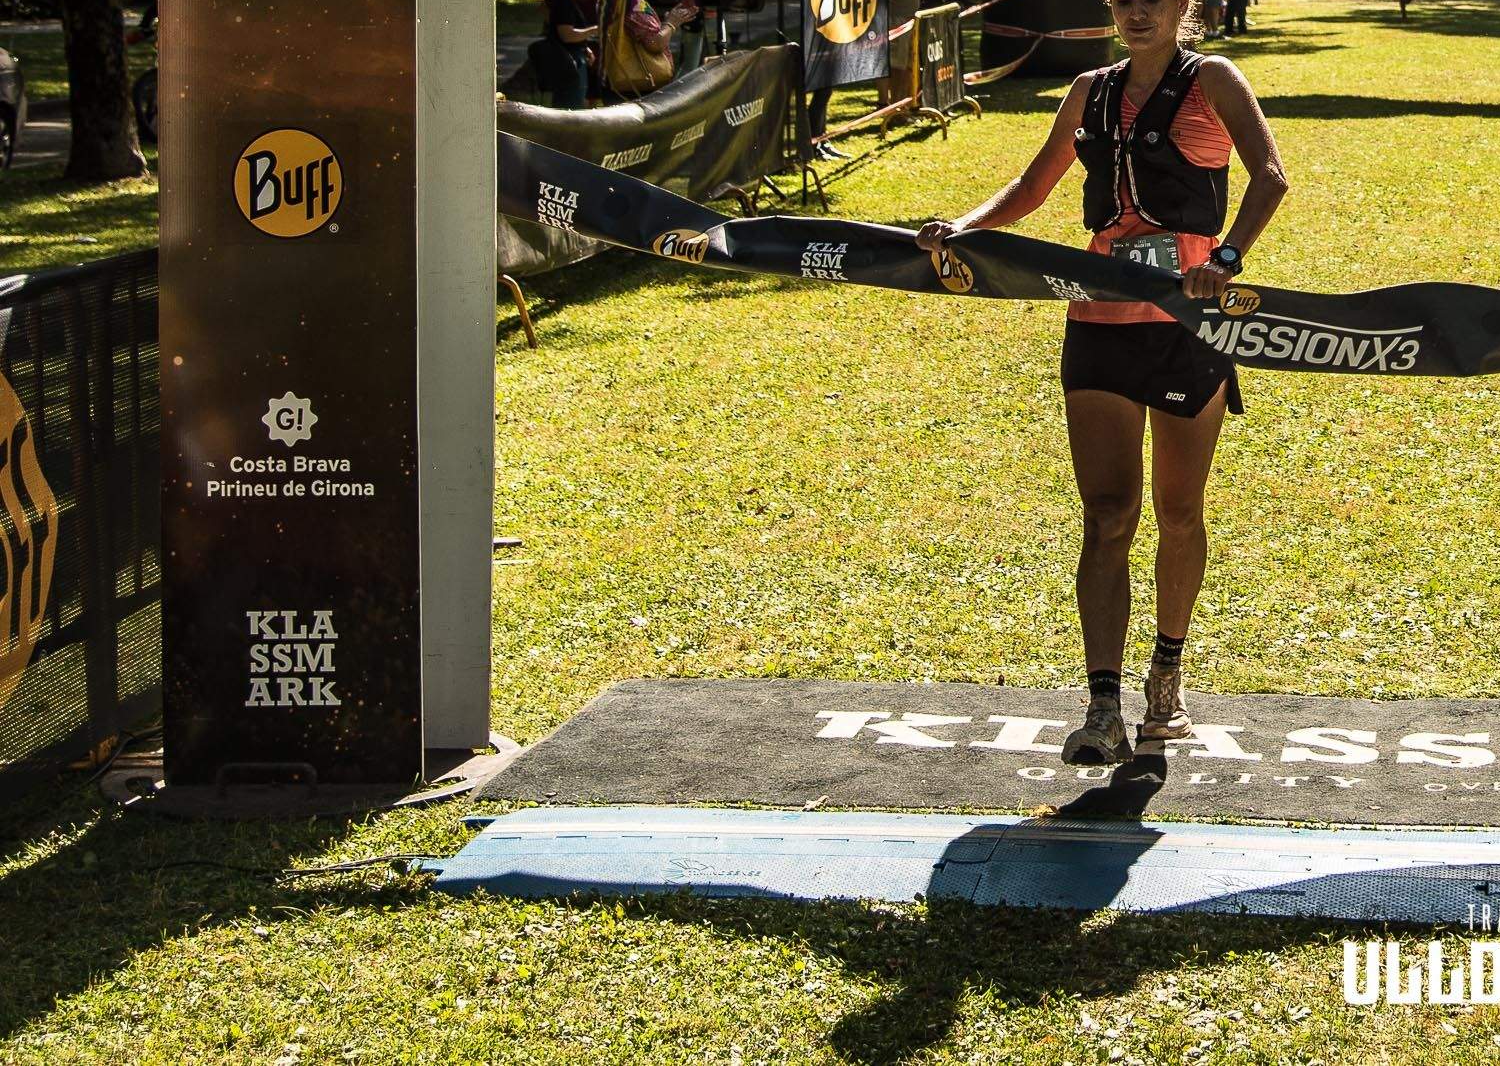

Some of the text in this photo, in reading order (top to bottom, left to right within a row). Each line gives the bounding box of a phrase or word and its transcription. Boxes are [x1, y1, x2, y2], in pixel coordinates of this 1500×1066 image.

[539, 181, 580, 209] KLA
[537, 198, 575, 224] SSM
[806, 242, 849, 254] KLA
[800, 251, 844, 270] SSM
[800, 267, 849, 281] ARK
[1042, 274, 1087, 294] KLA
[229, 455, 351, 473] Costa Brava
[207, 480, 375, 497] Pirineu de Girona
[245, 609, 339, 640] KLA
[249, 643, 336, 673] SSM
[244, 676, 342, 707] ARK
